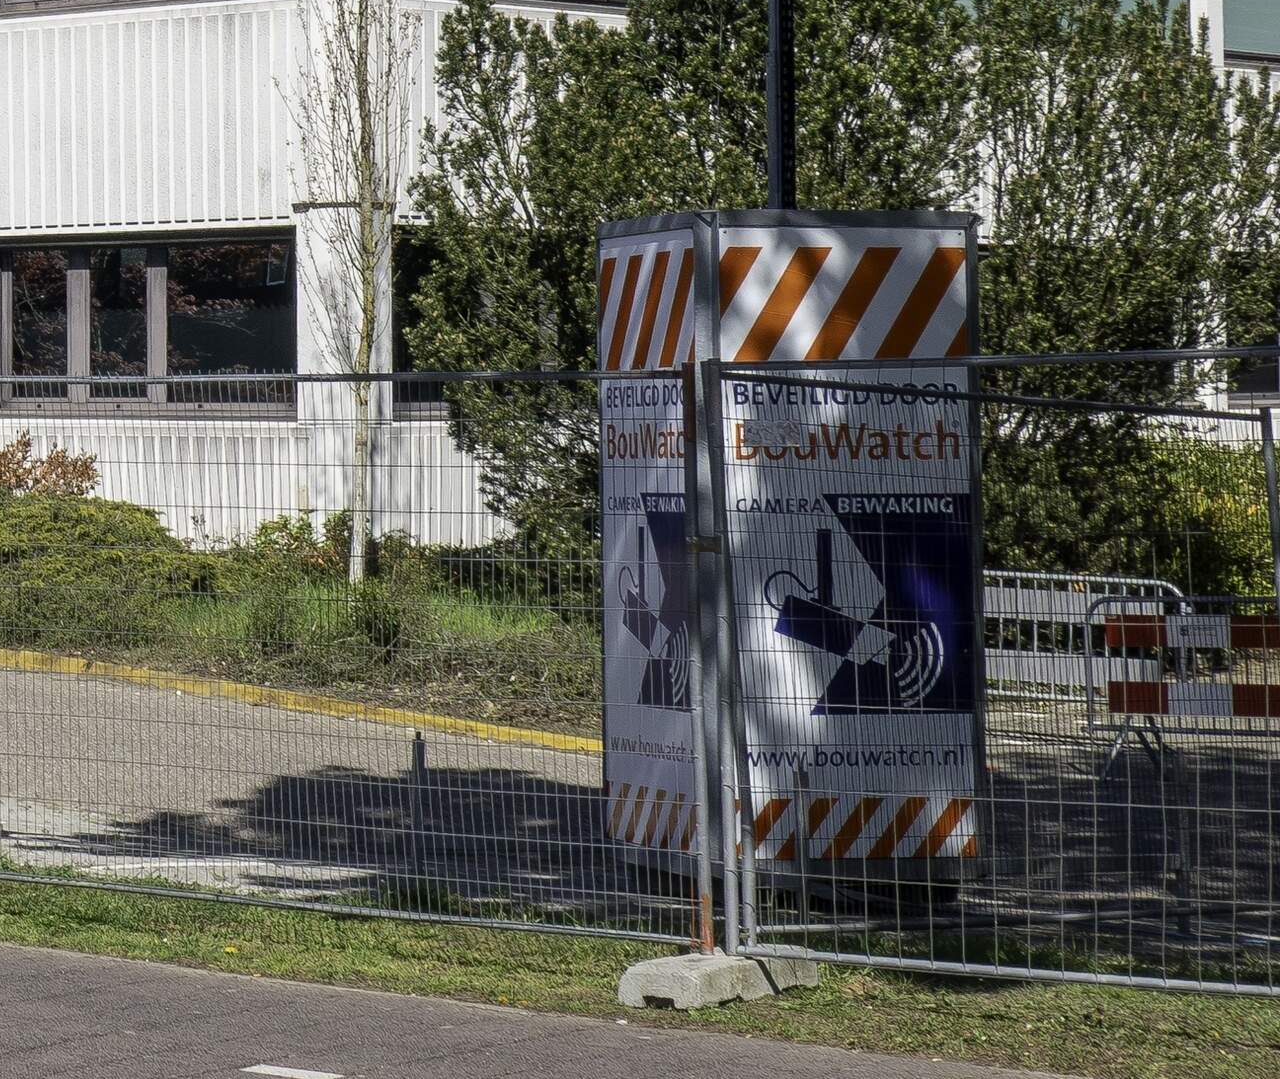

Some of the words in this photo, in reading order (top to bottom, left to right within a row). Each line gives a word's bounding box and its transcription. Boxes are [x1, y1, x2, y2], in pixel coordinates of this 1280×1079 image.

[606, 384, 660, 408] BEVEILIGD
[663, 383, 684, 406] DOO
[733, 383, 870, 405] BEVEILIGD
[879, 383, 959, 405] DOOR
[607, 423, 685, 460] BouWatc
[608, 496, 641, 512] CAMERA
[646, 496, 686, 513] BEWAKIN
[736, 497, 824, 513] CAMERA
[837, 496, 954, 514] BEWAKING
